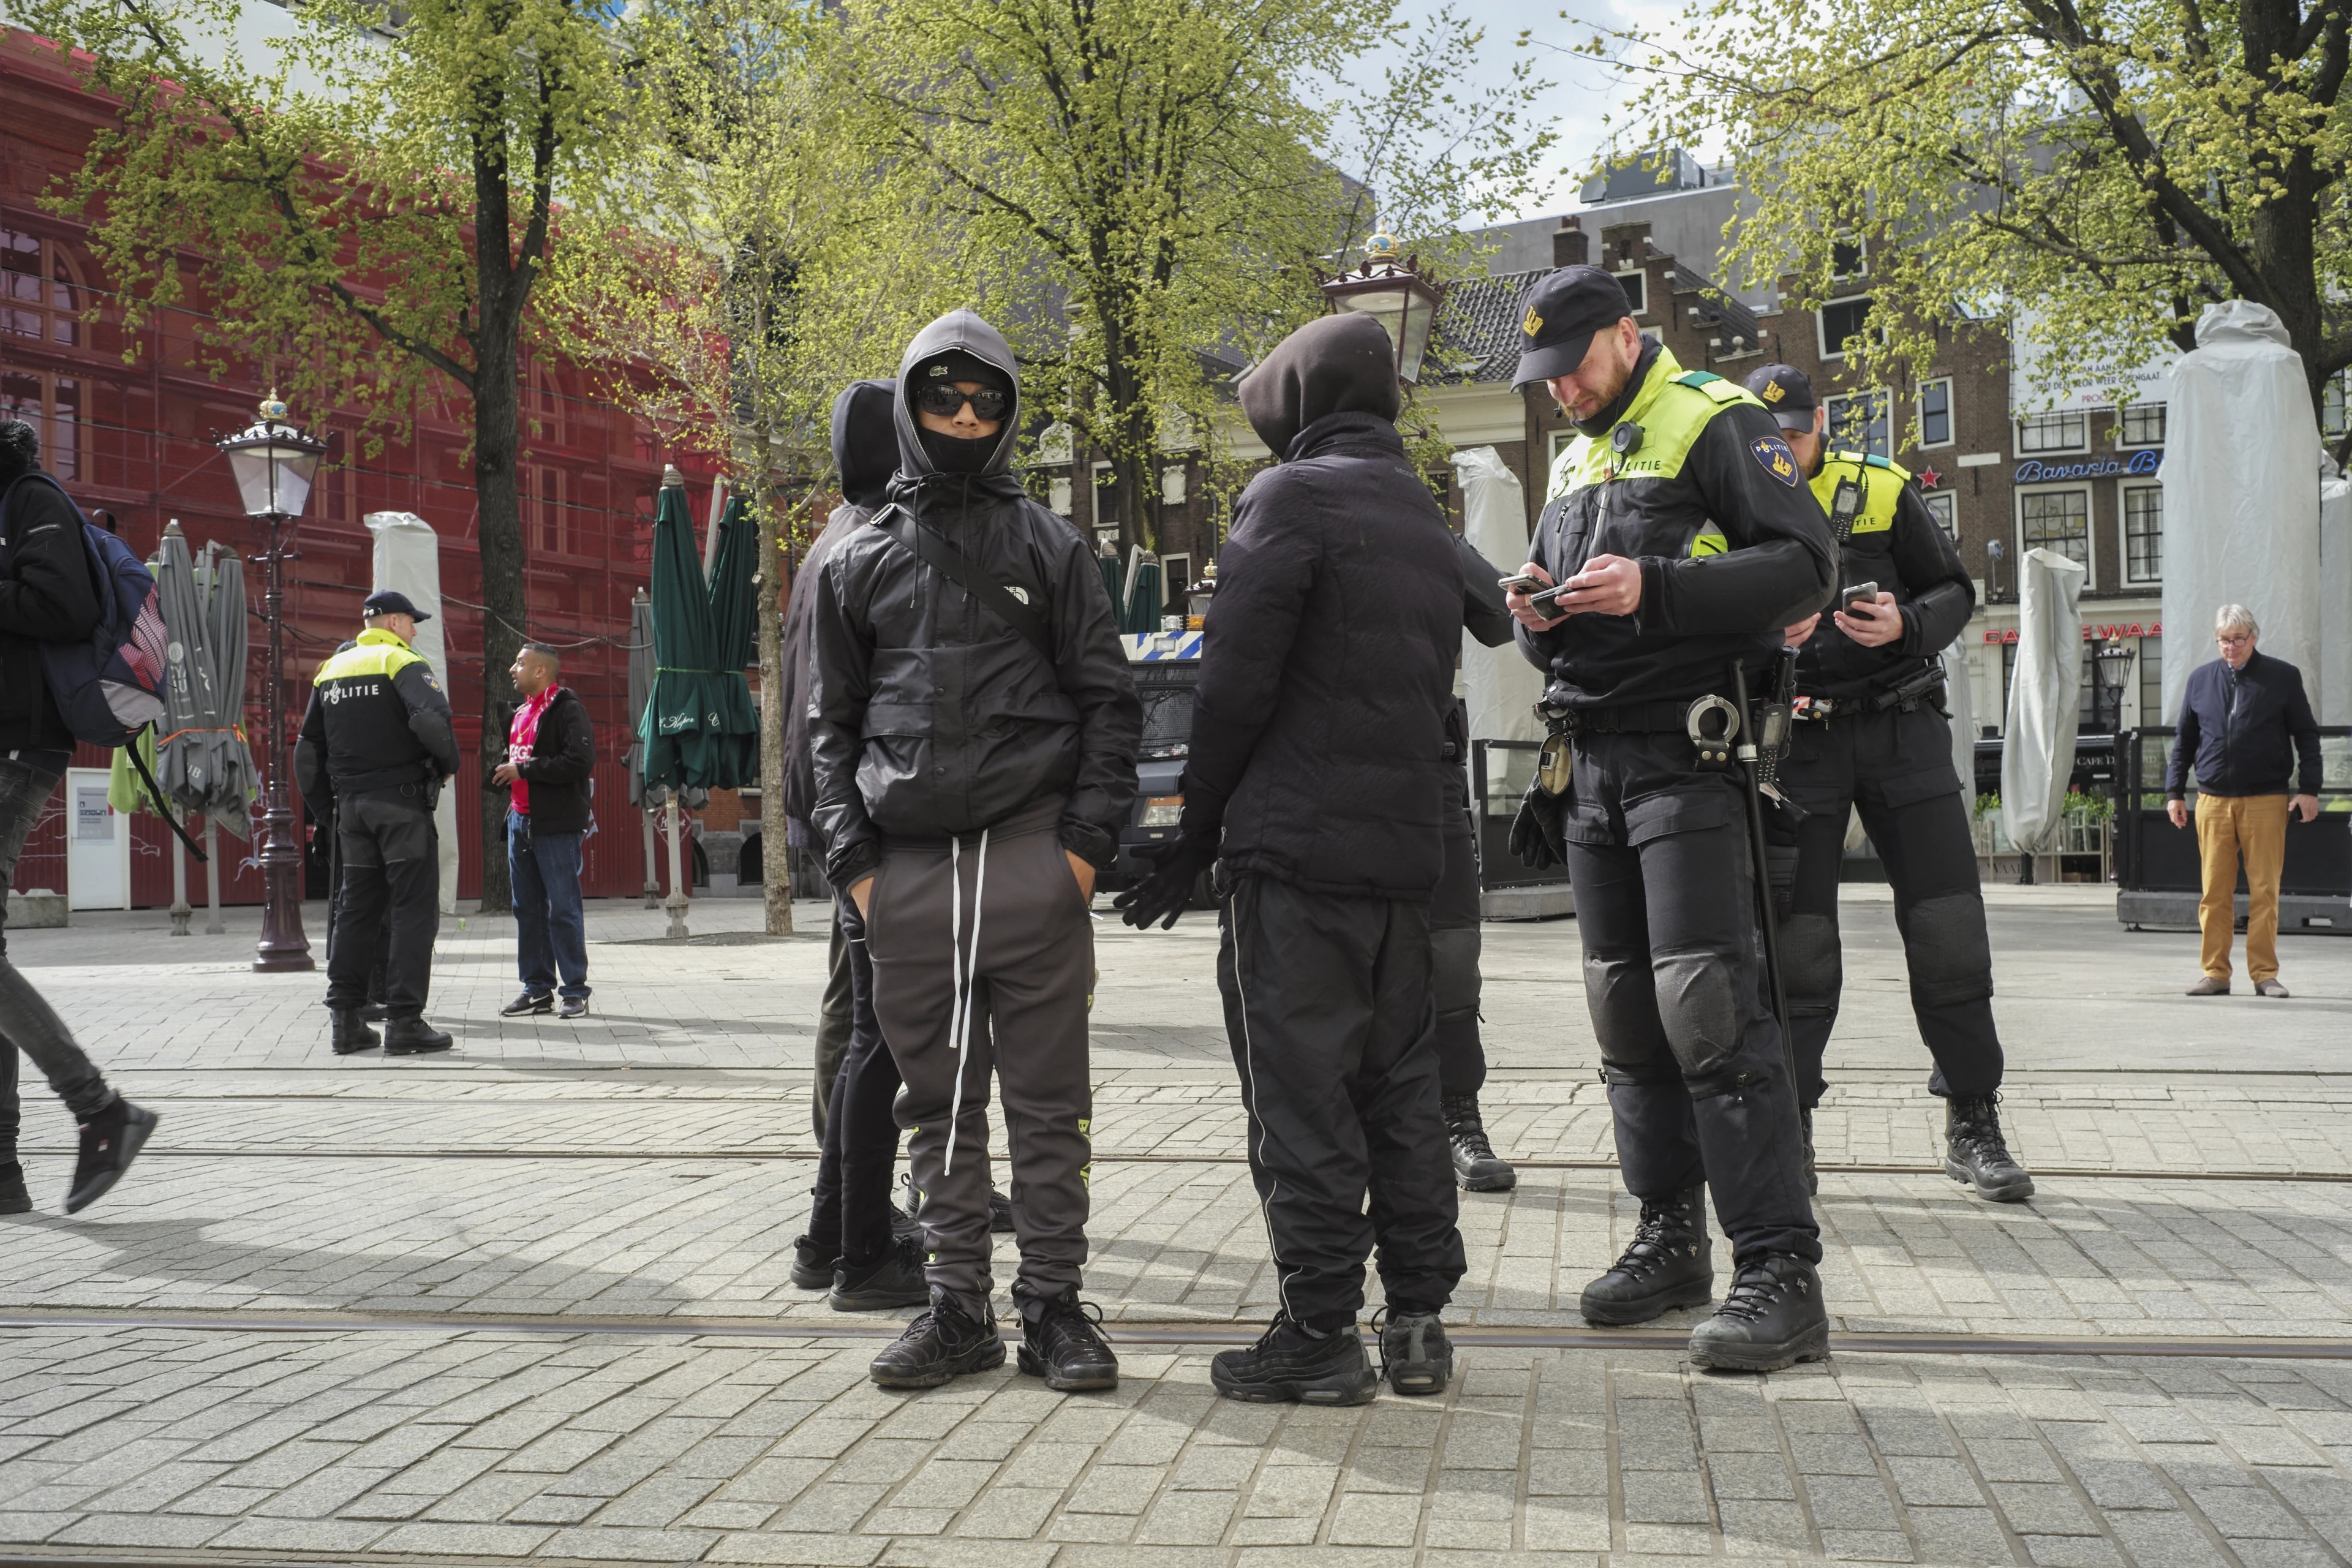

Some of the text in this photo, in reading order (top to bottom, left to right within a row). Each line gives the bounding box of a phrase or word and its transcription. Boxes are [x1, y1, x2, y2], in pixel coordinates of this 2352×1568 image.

[2095, 376, 2116, 386] WEER
[1755, 440, 1788, 453] POLITIE
[1622, 460, 1661, 472] LITIE
[2015, 455, 2121, 482] Bavaria
[324, 681, 379, 704] POLITIE
